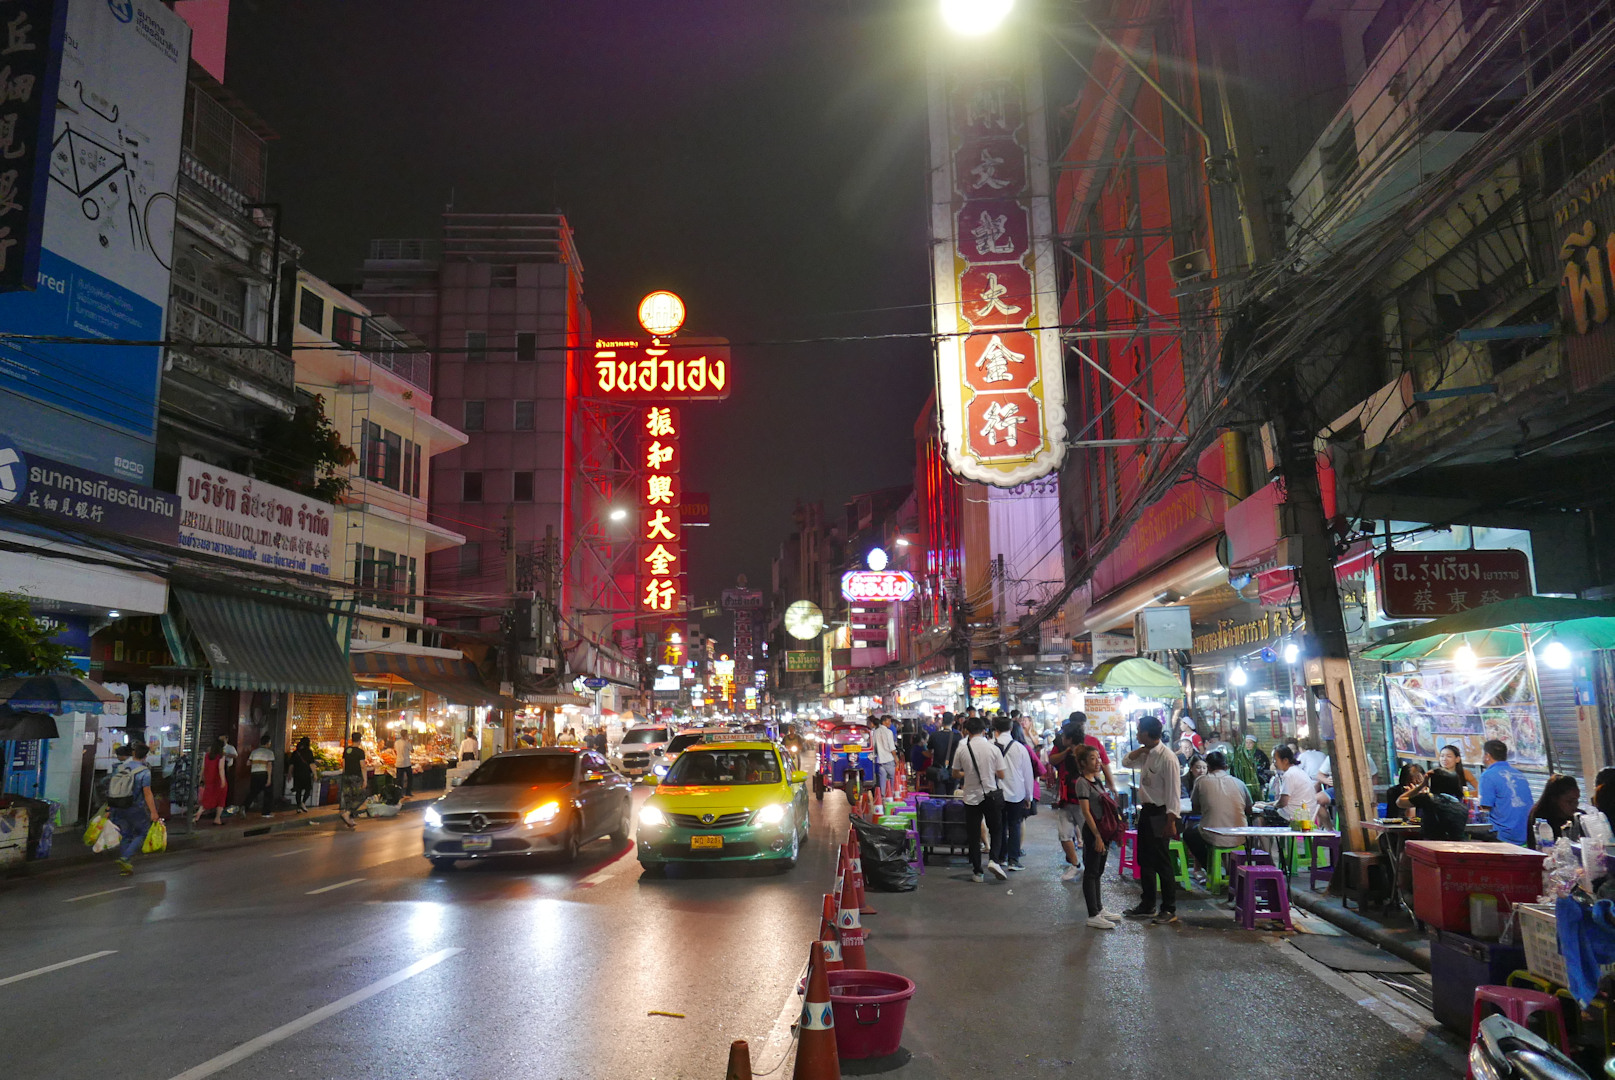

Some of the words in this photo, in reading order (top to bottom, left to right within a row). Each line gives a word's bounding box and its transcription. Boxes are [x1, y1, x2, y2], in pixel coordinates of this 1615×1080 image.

[188, 472, 237, 512] บริษัท
[298, 503, 330, 537] จำกัด
[643, 406, 677, 610] 振和興大金行
[1413, 588, 1518, 613] 蔡東發
